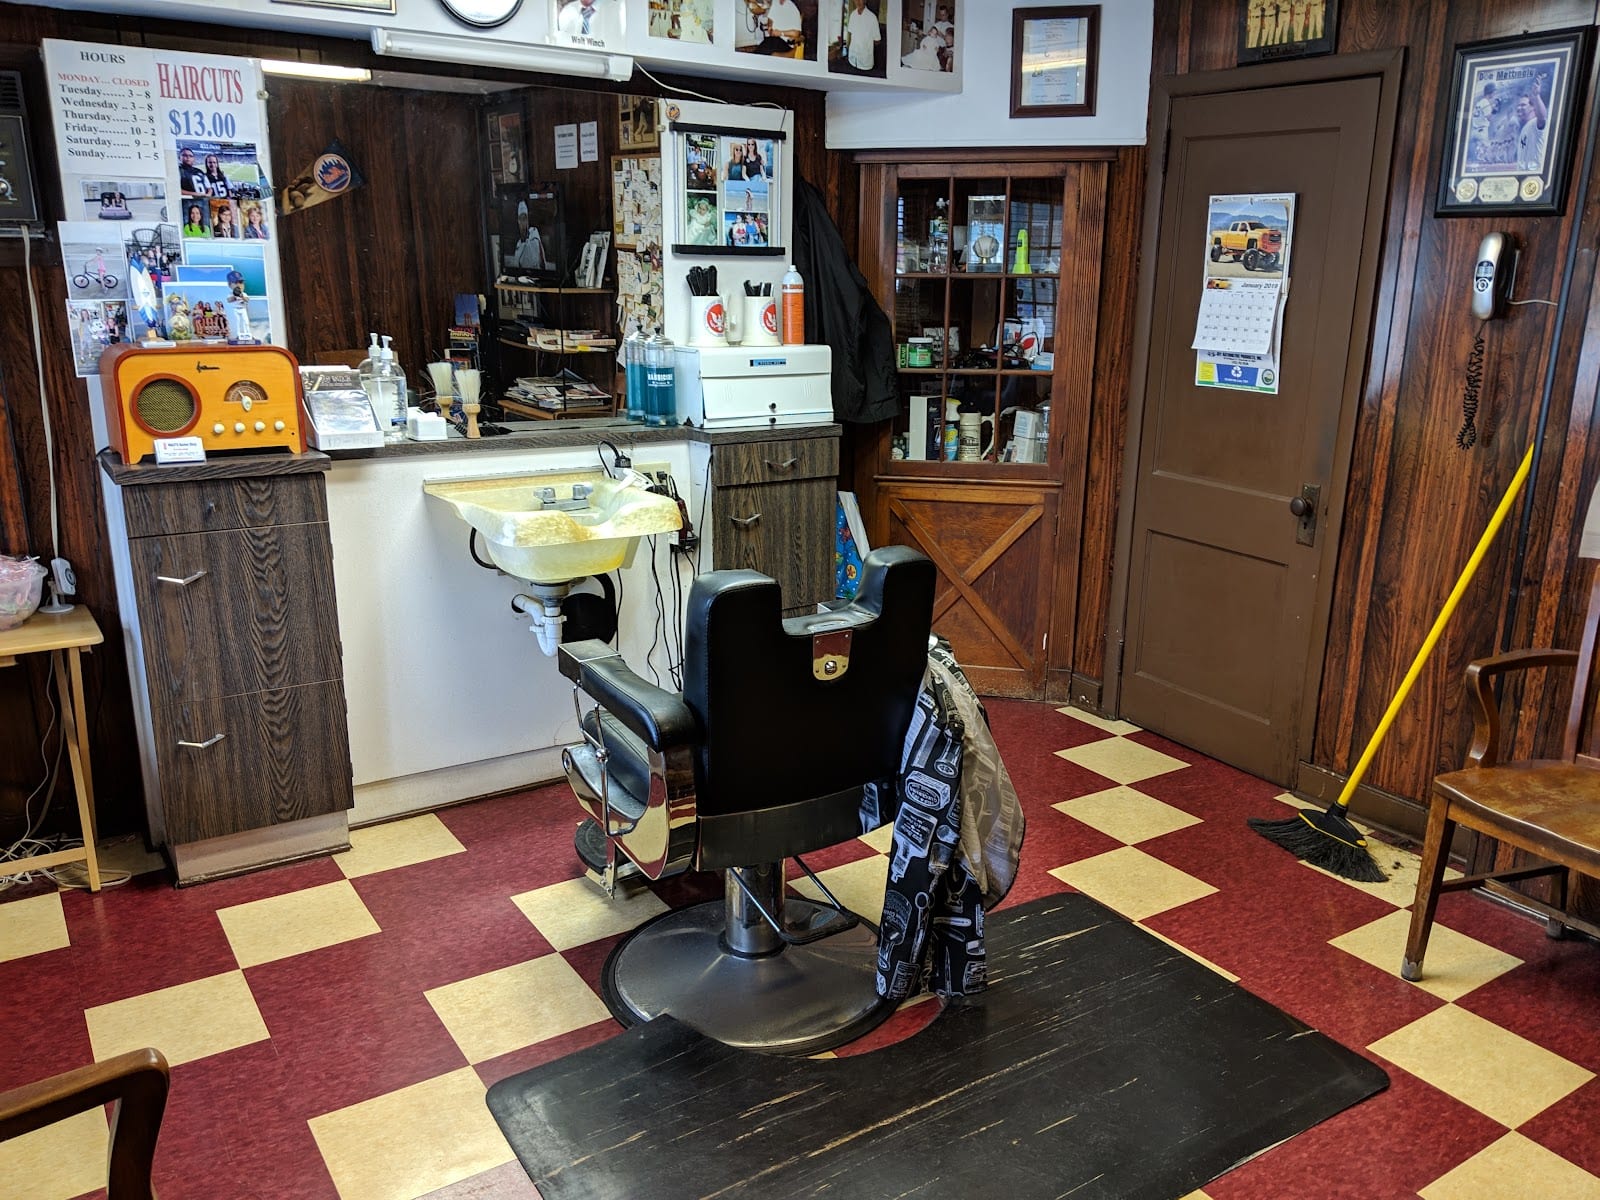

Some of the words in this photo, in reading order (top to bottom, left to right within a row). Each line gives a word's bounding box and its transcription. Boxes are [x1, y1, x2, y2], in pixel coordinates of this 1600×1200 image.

[80, 51, 126, 64] HOURS
[111, 77, 150, 87] CLOSED
[156, 62, 243, 105] HAIRCUTS
[168, 108, 236, 139] $13.00
[1241, 282, 1262, 290] January
